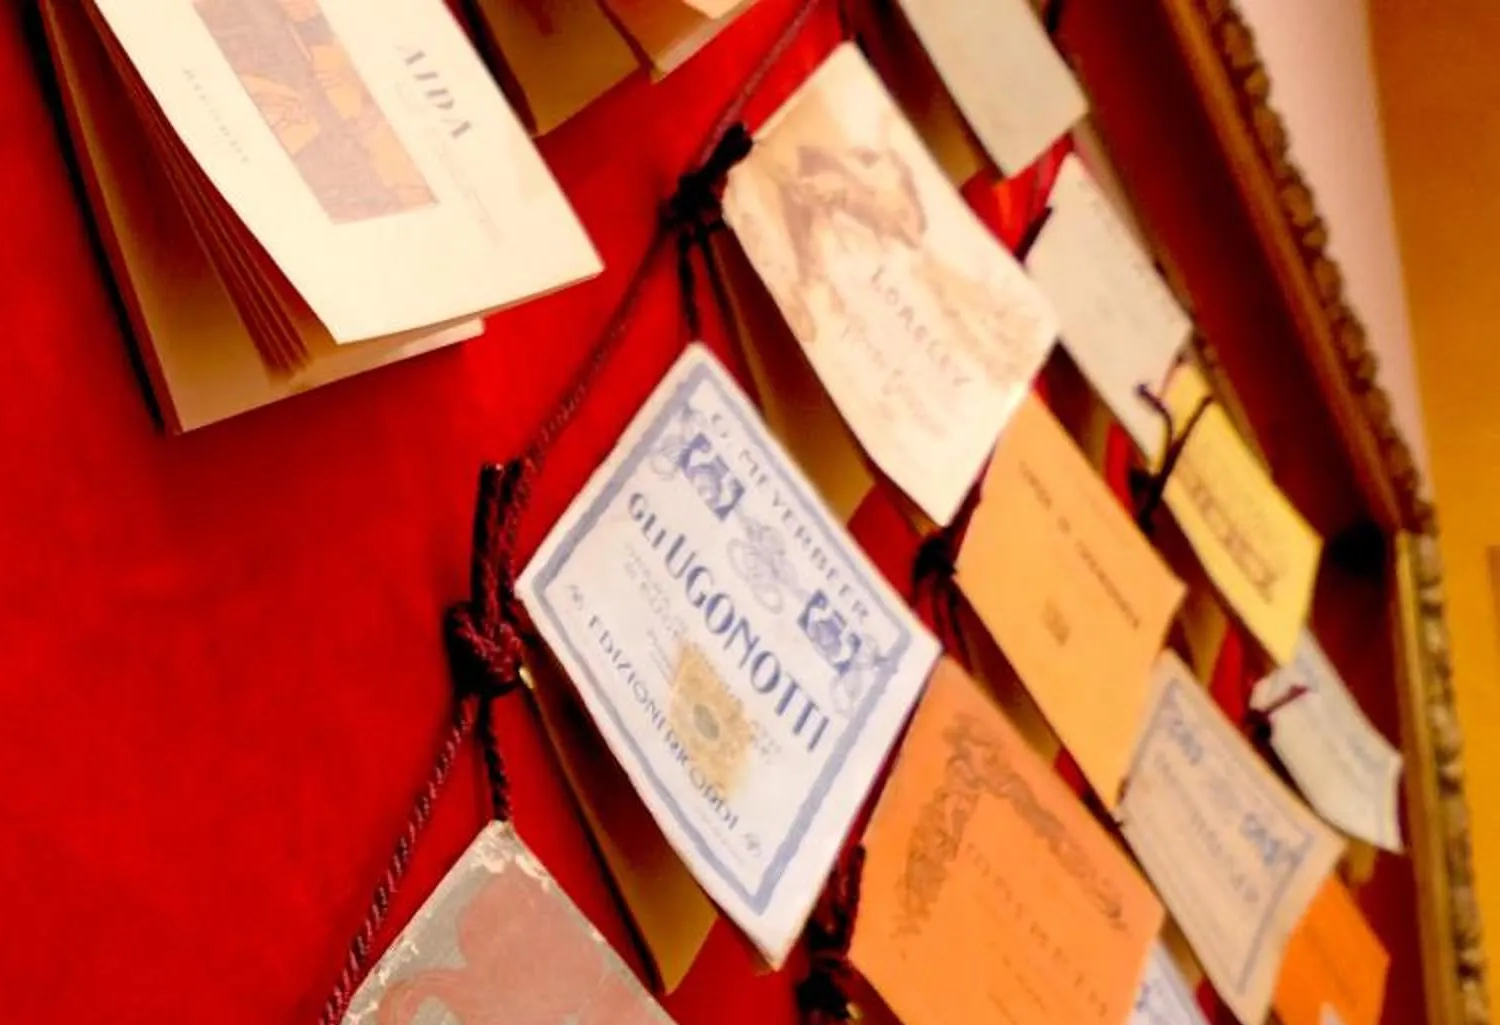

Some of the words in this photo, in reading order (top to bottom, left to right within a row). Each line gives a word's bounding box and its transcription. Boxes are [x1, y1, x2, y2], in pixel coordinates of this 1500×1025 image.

[394, 44, 477, 140] AIDA
[737, 446, 869, 626] MEYERBEER
[587, 612, 666, 731] EDIZIONI
[623, 488, 668, 552] GLI
[662, 531, 831, 756] UGONOTTI
